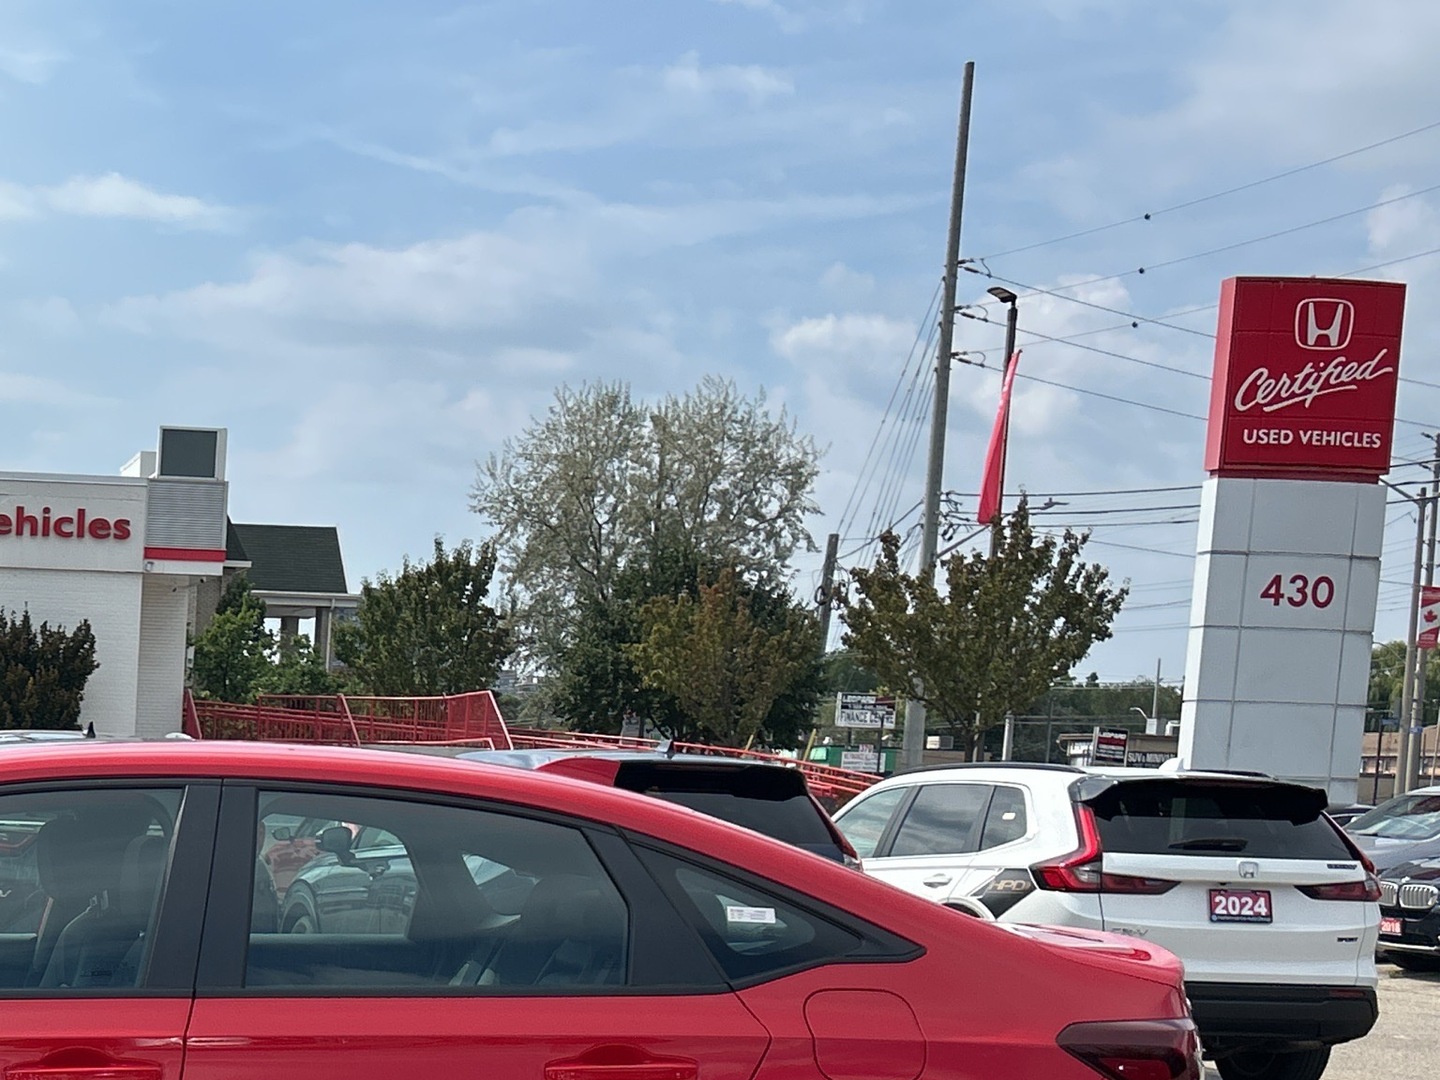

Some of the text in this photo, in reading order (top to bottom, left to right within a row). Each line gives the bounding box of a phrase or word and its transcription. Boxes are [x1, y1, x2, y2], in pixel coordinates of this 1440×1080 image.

[1234, 349, 1393, 412] Certified
[1243, 429, 1381, 448] USED VEHICLES
[1260, 574, 1335, 609] 430
[1214, 895, 1268, 916] 2024
